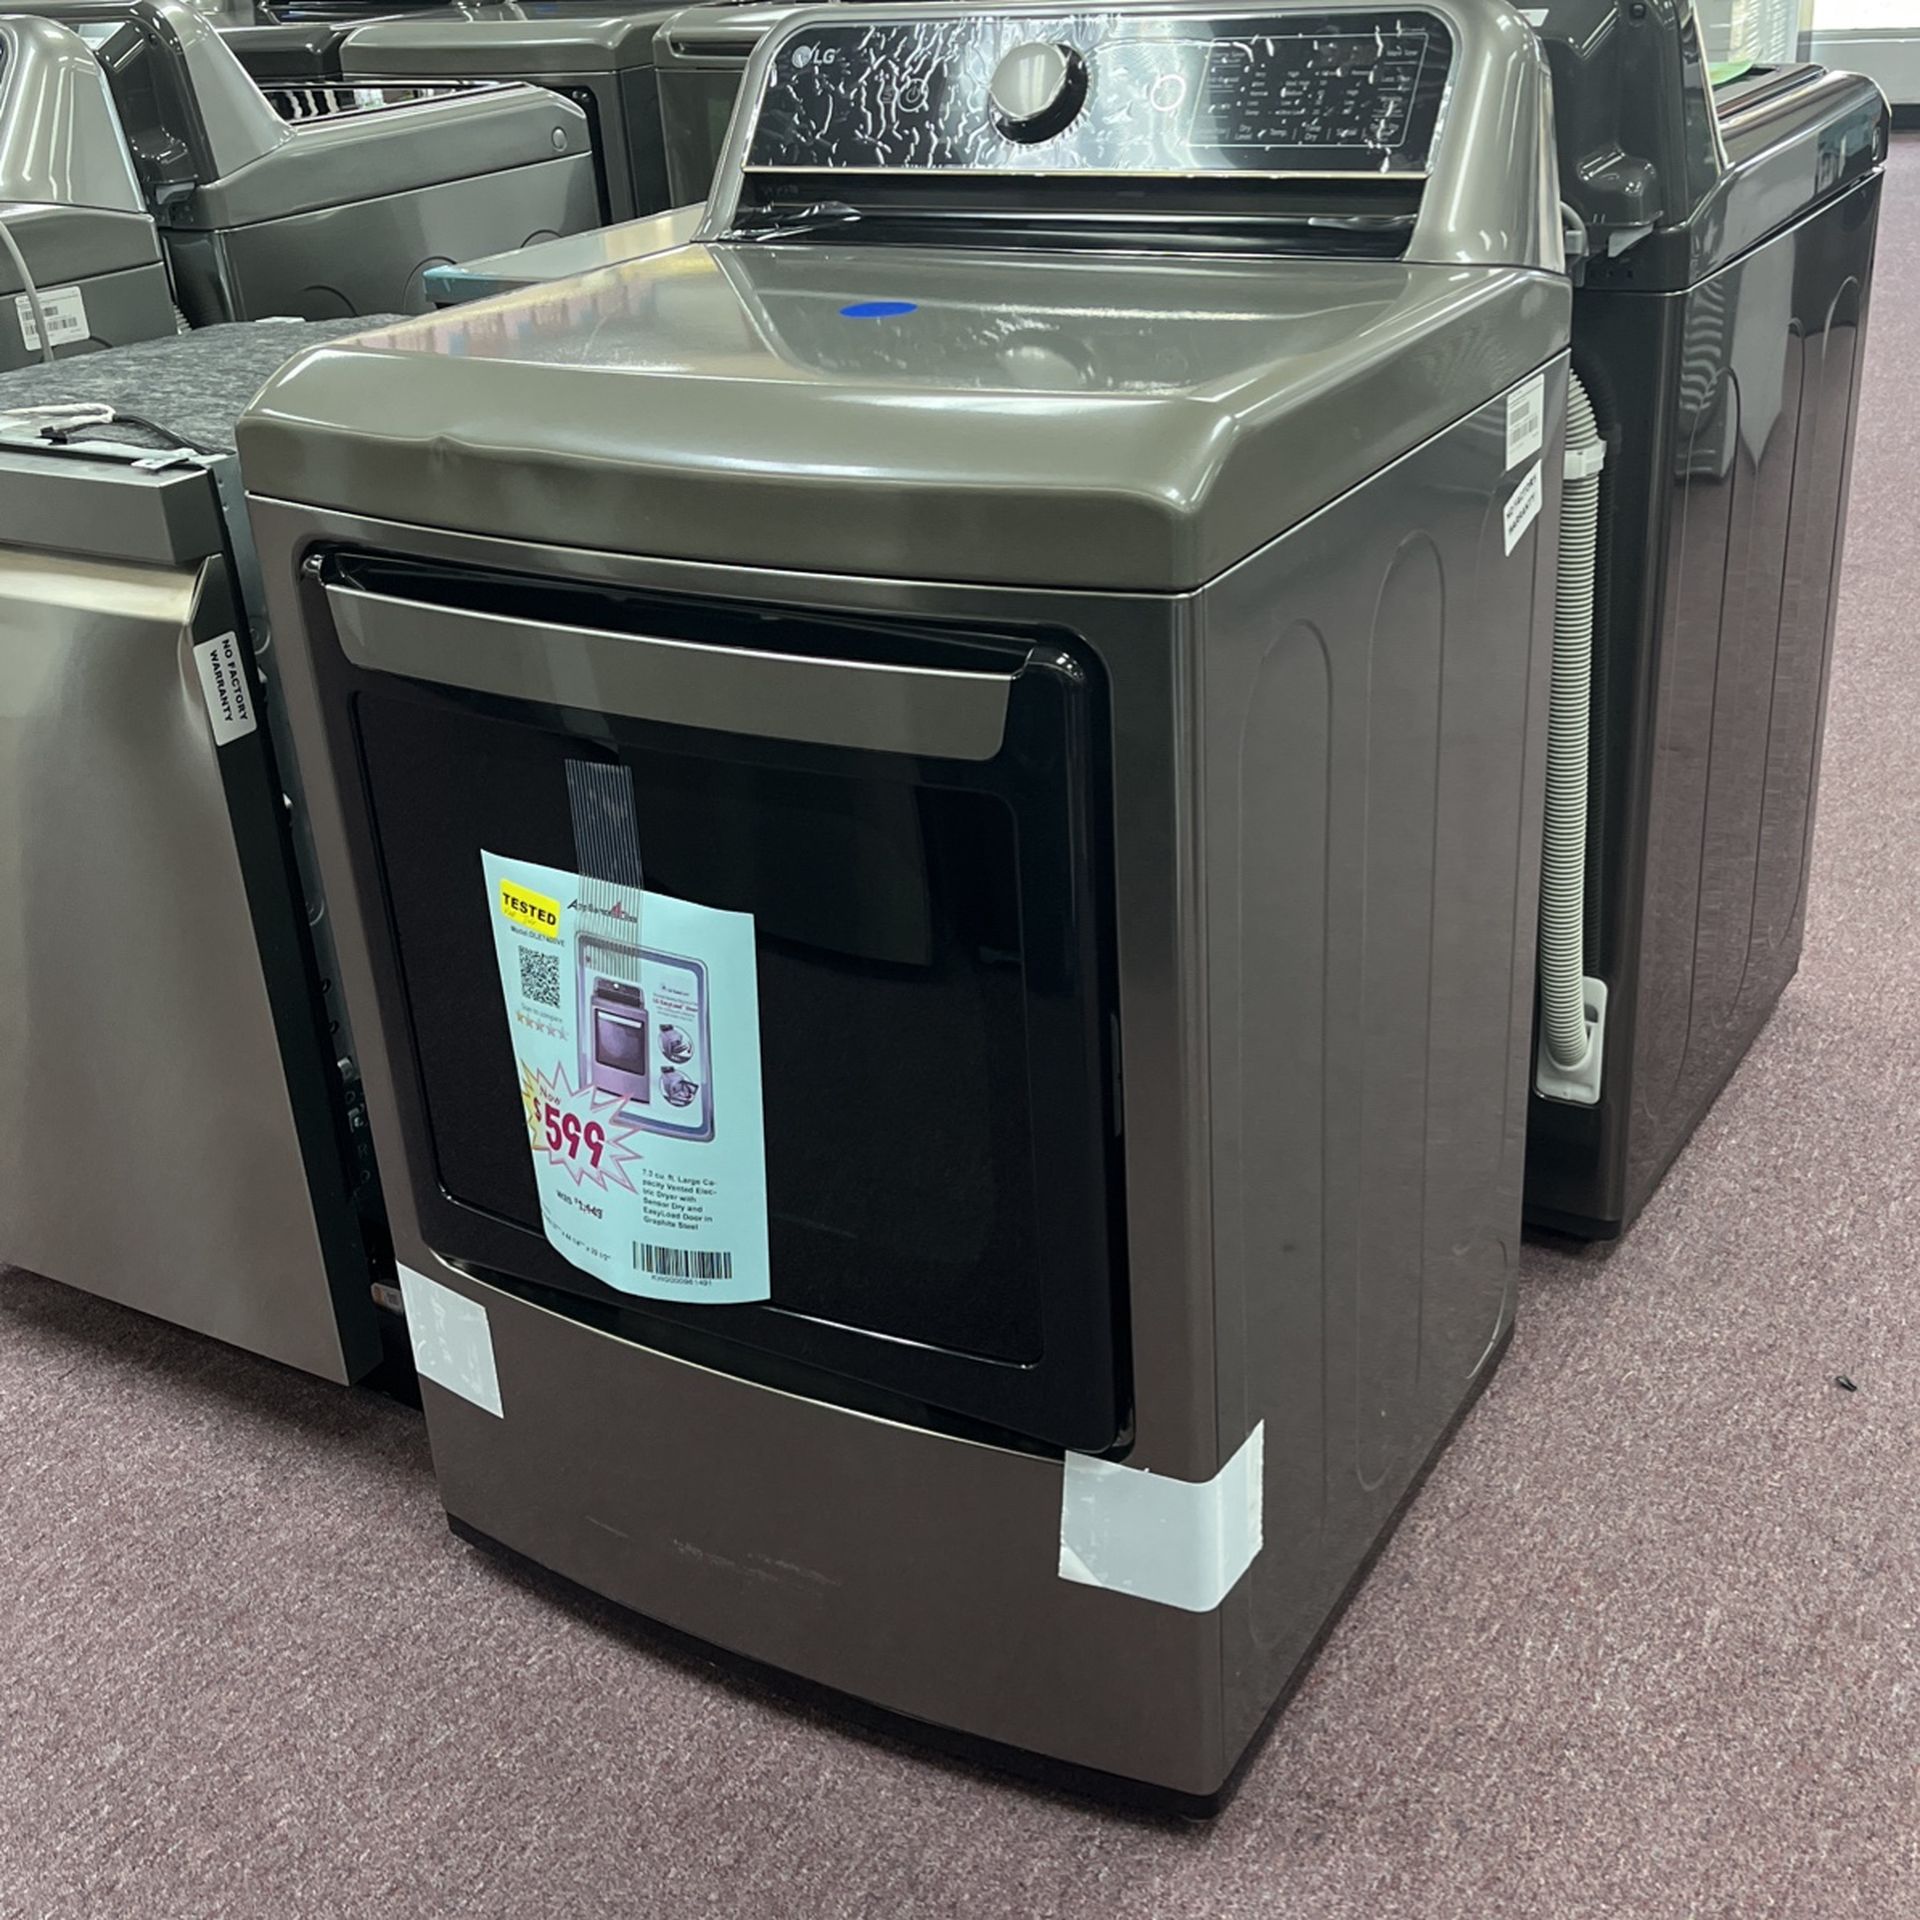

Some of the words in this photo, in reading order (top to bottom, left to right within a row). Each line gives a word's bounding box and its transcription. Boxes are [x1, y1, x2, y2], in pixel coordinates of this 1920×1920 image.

[813, 49, 835, 64] LG
[210, 649, 233, 721] WARRANTY
[222, 639, 233, 659] NO
[228, 662, 248, 720] FACTORY
[503, 892, 557, 926] TESTED
[642, 1179, 666, 1191] pacity
[666, 1182, 694, 1194] Vented
[695, 1186, 718, 1196] Elec-
[677, 1175, 701, 1186] Large
[642, 1187, 655, 1197] tric
[655, 1190, 678, 1201] Dryer
[643, 1196, 670, 1208] Sensor
[671, 1202, 686, 1212] Dry
[687, 1205, 704, 1213] and
[643, 1205, 681, 1220] EasyLoad
[682, 1212, 702, 1222] Door
[704, 1215, 714, 1223] in
[643, 1215, 677, 1228] Graphite
[677, 1221, 699, 1231] Steel
